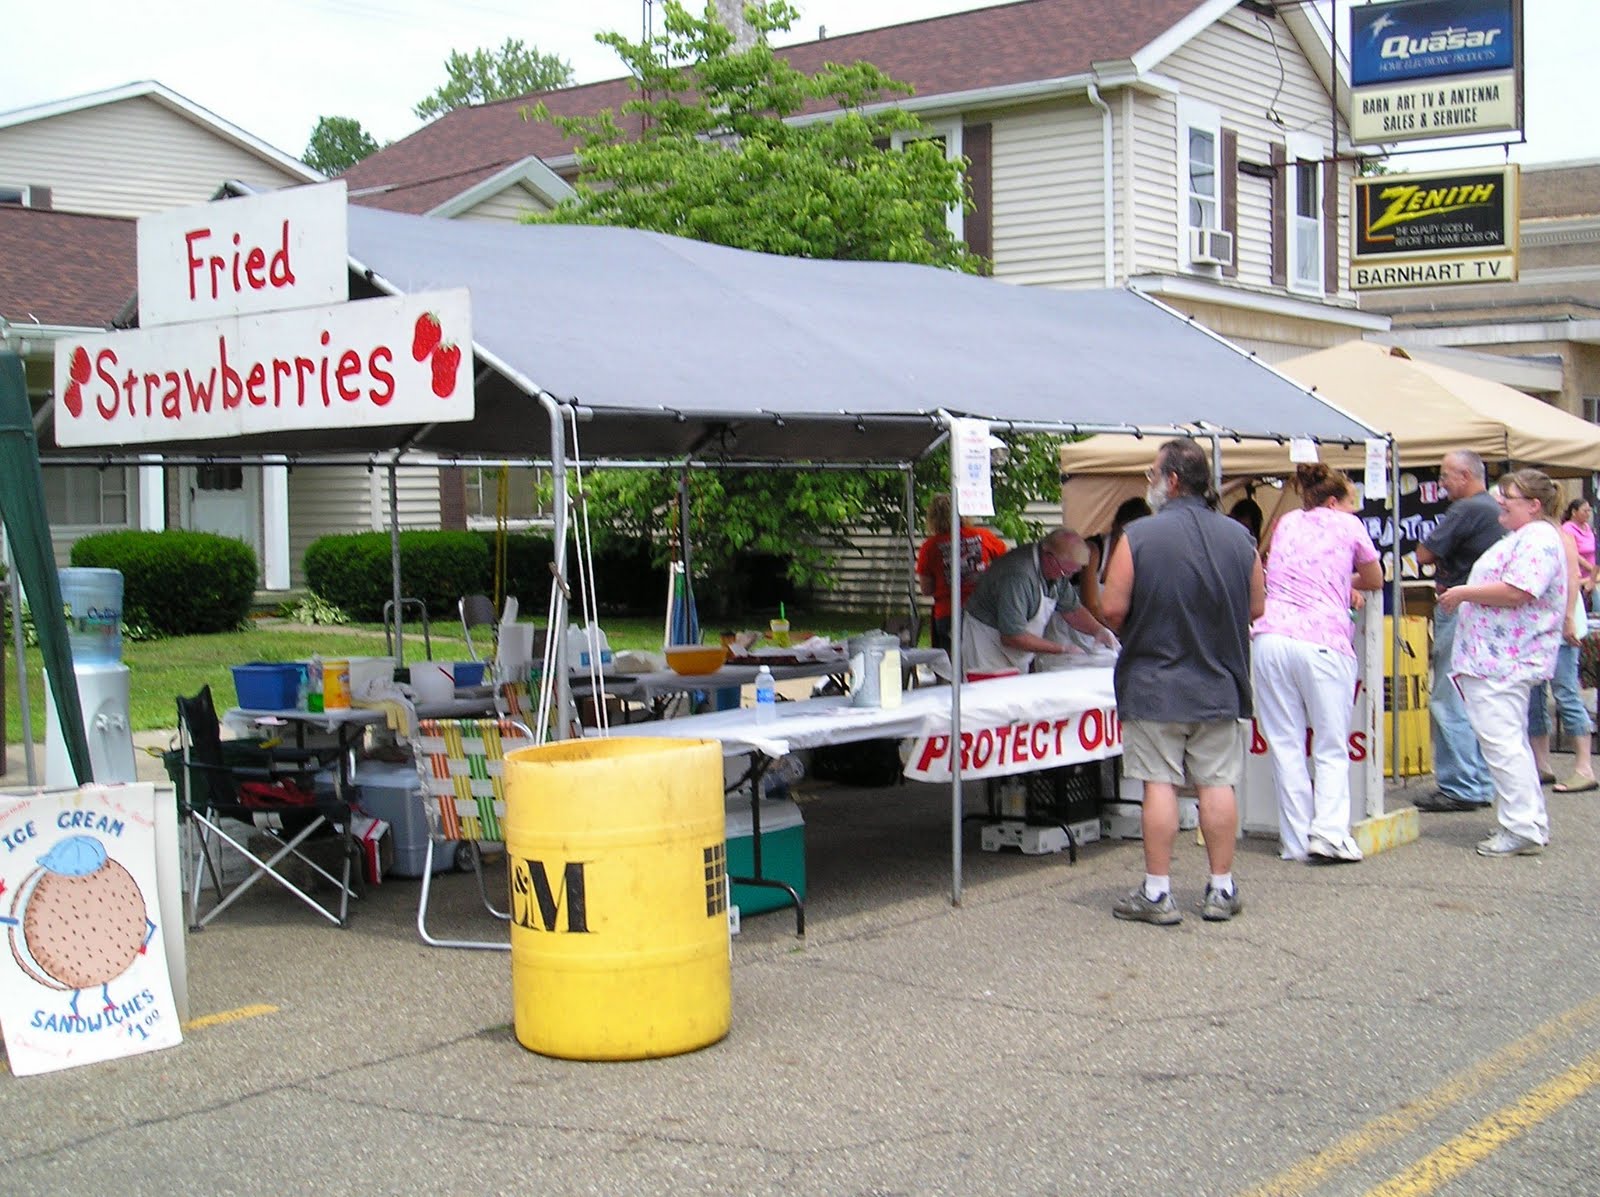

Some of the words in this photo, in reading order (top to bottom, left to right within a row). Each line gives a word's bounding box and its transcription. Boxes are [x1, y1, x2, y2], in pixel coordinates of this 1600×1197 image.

[1381, 27, 1501, 60] Quasar
[1362, 97, 1390, 115] BARN
[1397, 94, 1416, 111] ART
[1421, 92, 1434, 108] TV
[1438, 91, 1445, 106] &
[1450, 85, 1500, 105] ANTENNA
[1383, 113, 1415, 131] SALES
[1420, 112, 1427, 128] &
[1433, 107, 1477, 127] SERVICE
[1369, 183, 1496, 233] ZENITH
[185, 219, 296, 300] Fried
[1357, 263, 1465, 285] BARNHART
[1474, 261, 1501, 277] TV
[96, 330, 396, 420] Strawberries
[916, 719, 1069, 772] PROTECT
[2, 820, 37, 853] ICE
[57, 809, 125, 838] CREAM
[31, 988, 155, 1034] SANDWICHES
